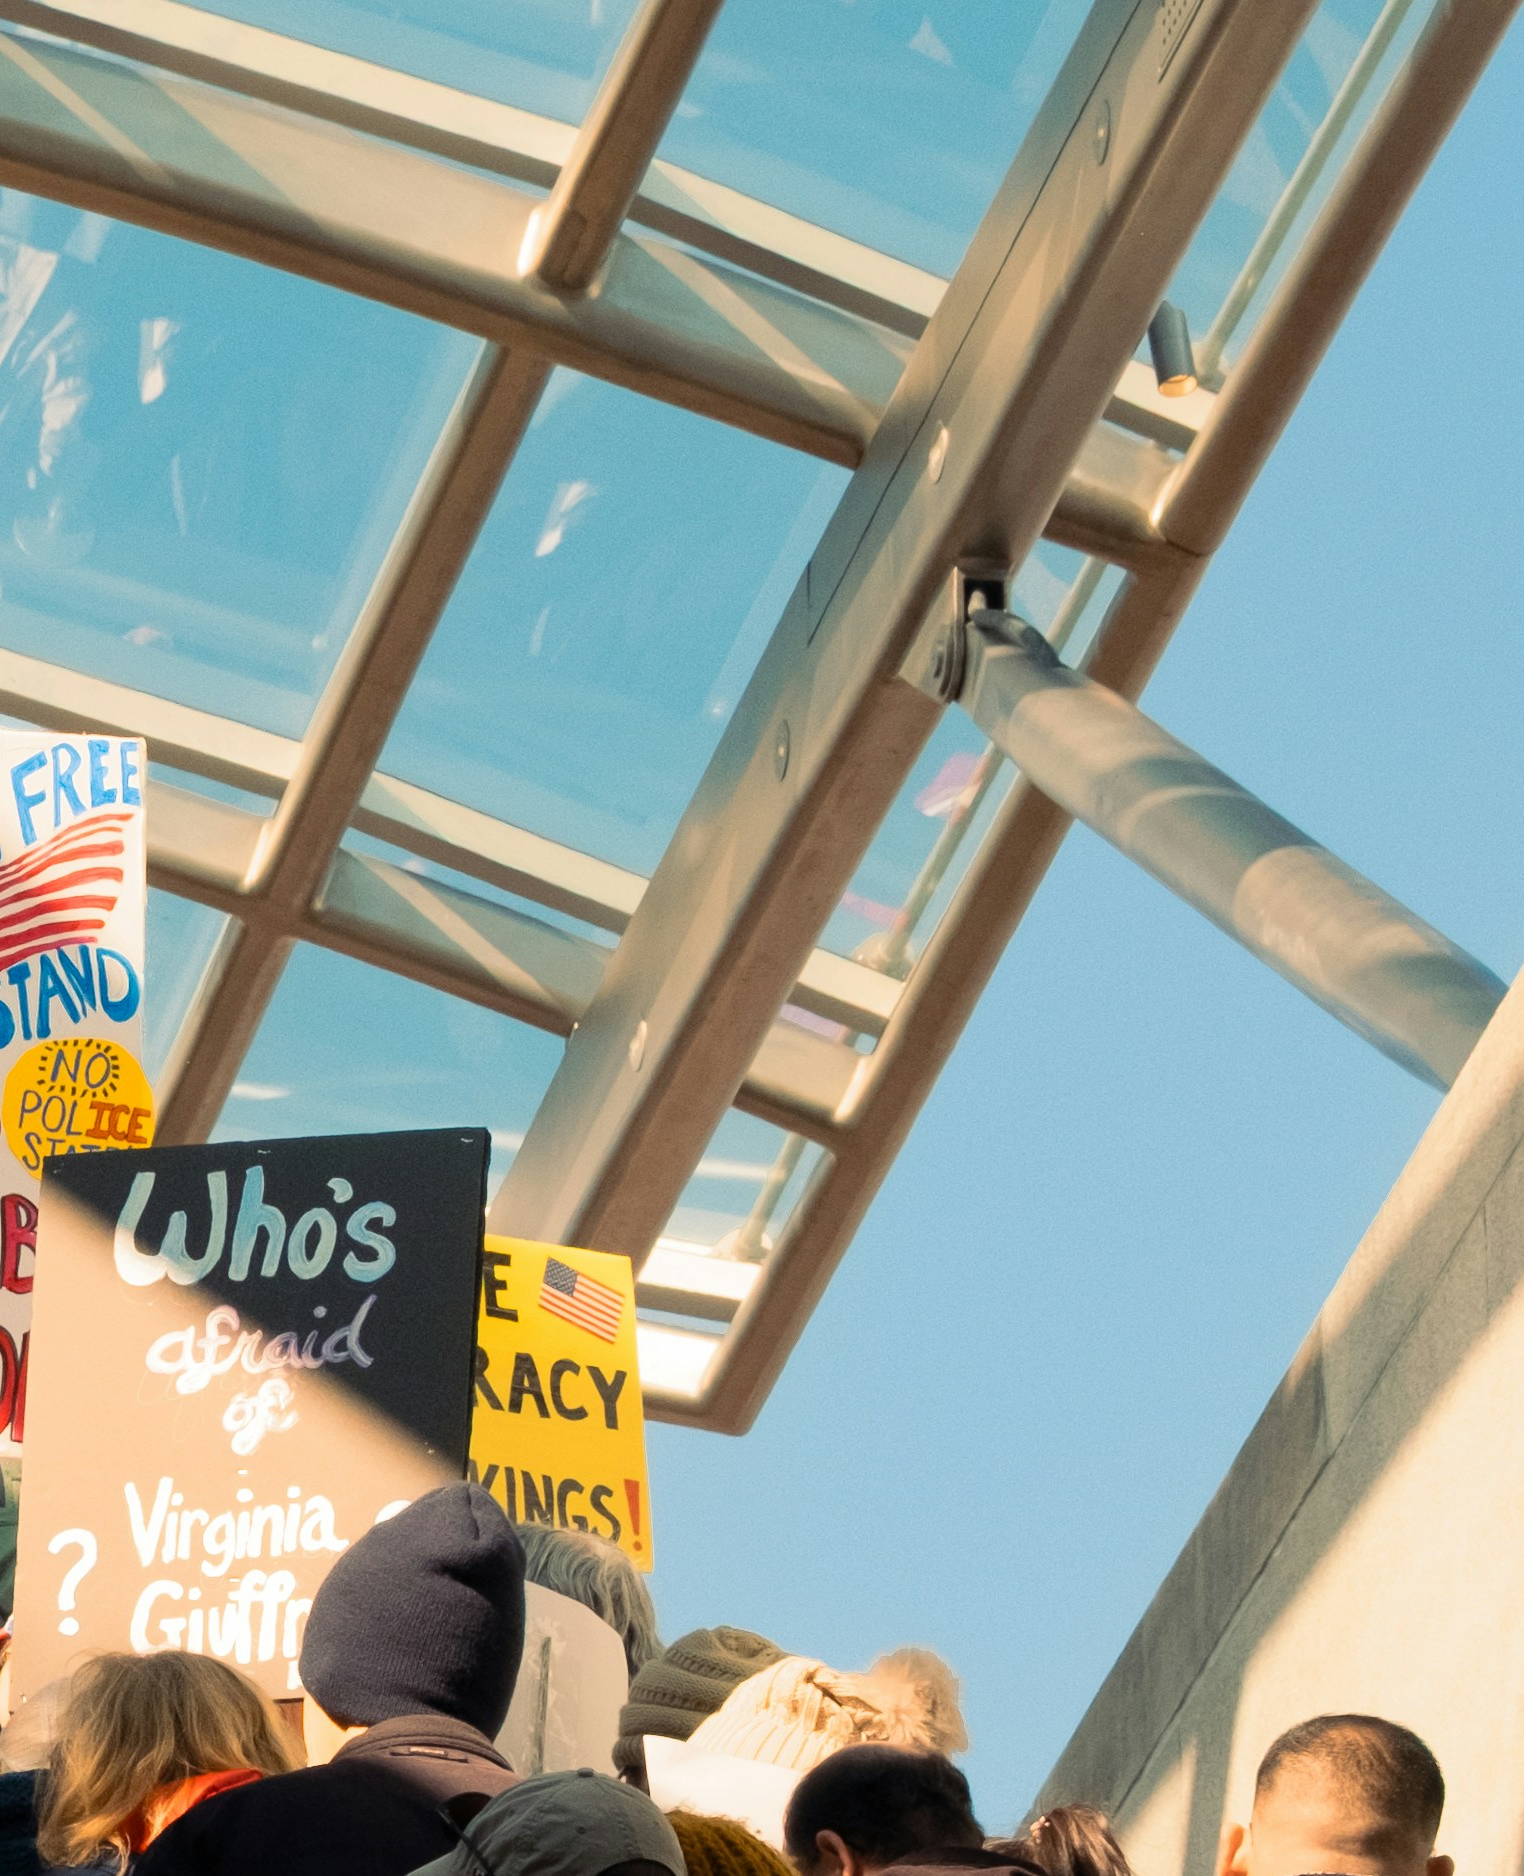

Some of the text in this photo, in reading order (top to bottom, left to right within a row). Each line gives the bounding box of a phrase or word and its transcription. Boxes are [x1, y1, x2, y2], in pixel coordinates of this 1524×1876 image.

[9, 738, 143, 848] FREE
[18, 1089, 152, 1144] POLICE
[50, 1049, 111, 1089] NO
[113, 1165, 397, 1287] Who's
[145, 1294, 379, 1395] afraid
[474, 1345, 628, 1430] RACY
[221, 1376, 301, 1457] of
[123, 1476, 350, 1577] Virginia
[47, 1527, 98, 1637] ?
[129, 1568, 314, 1665] Giuffr
